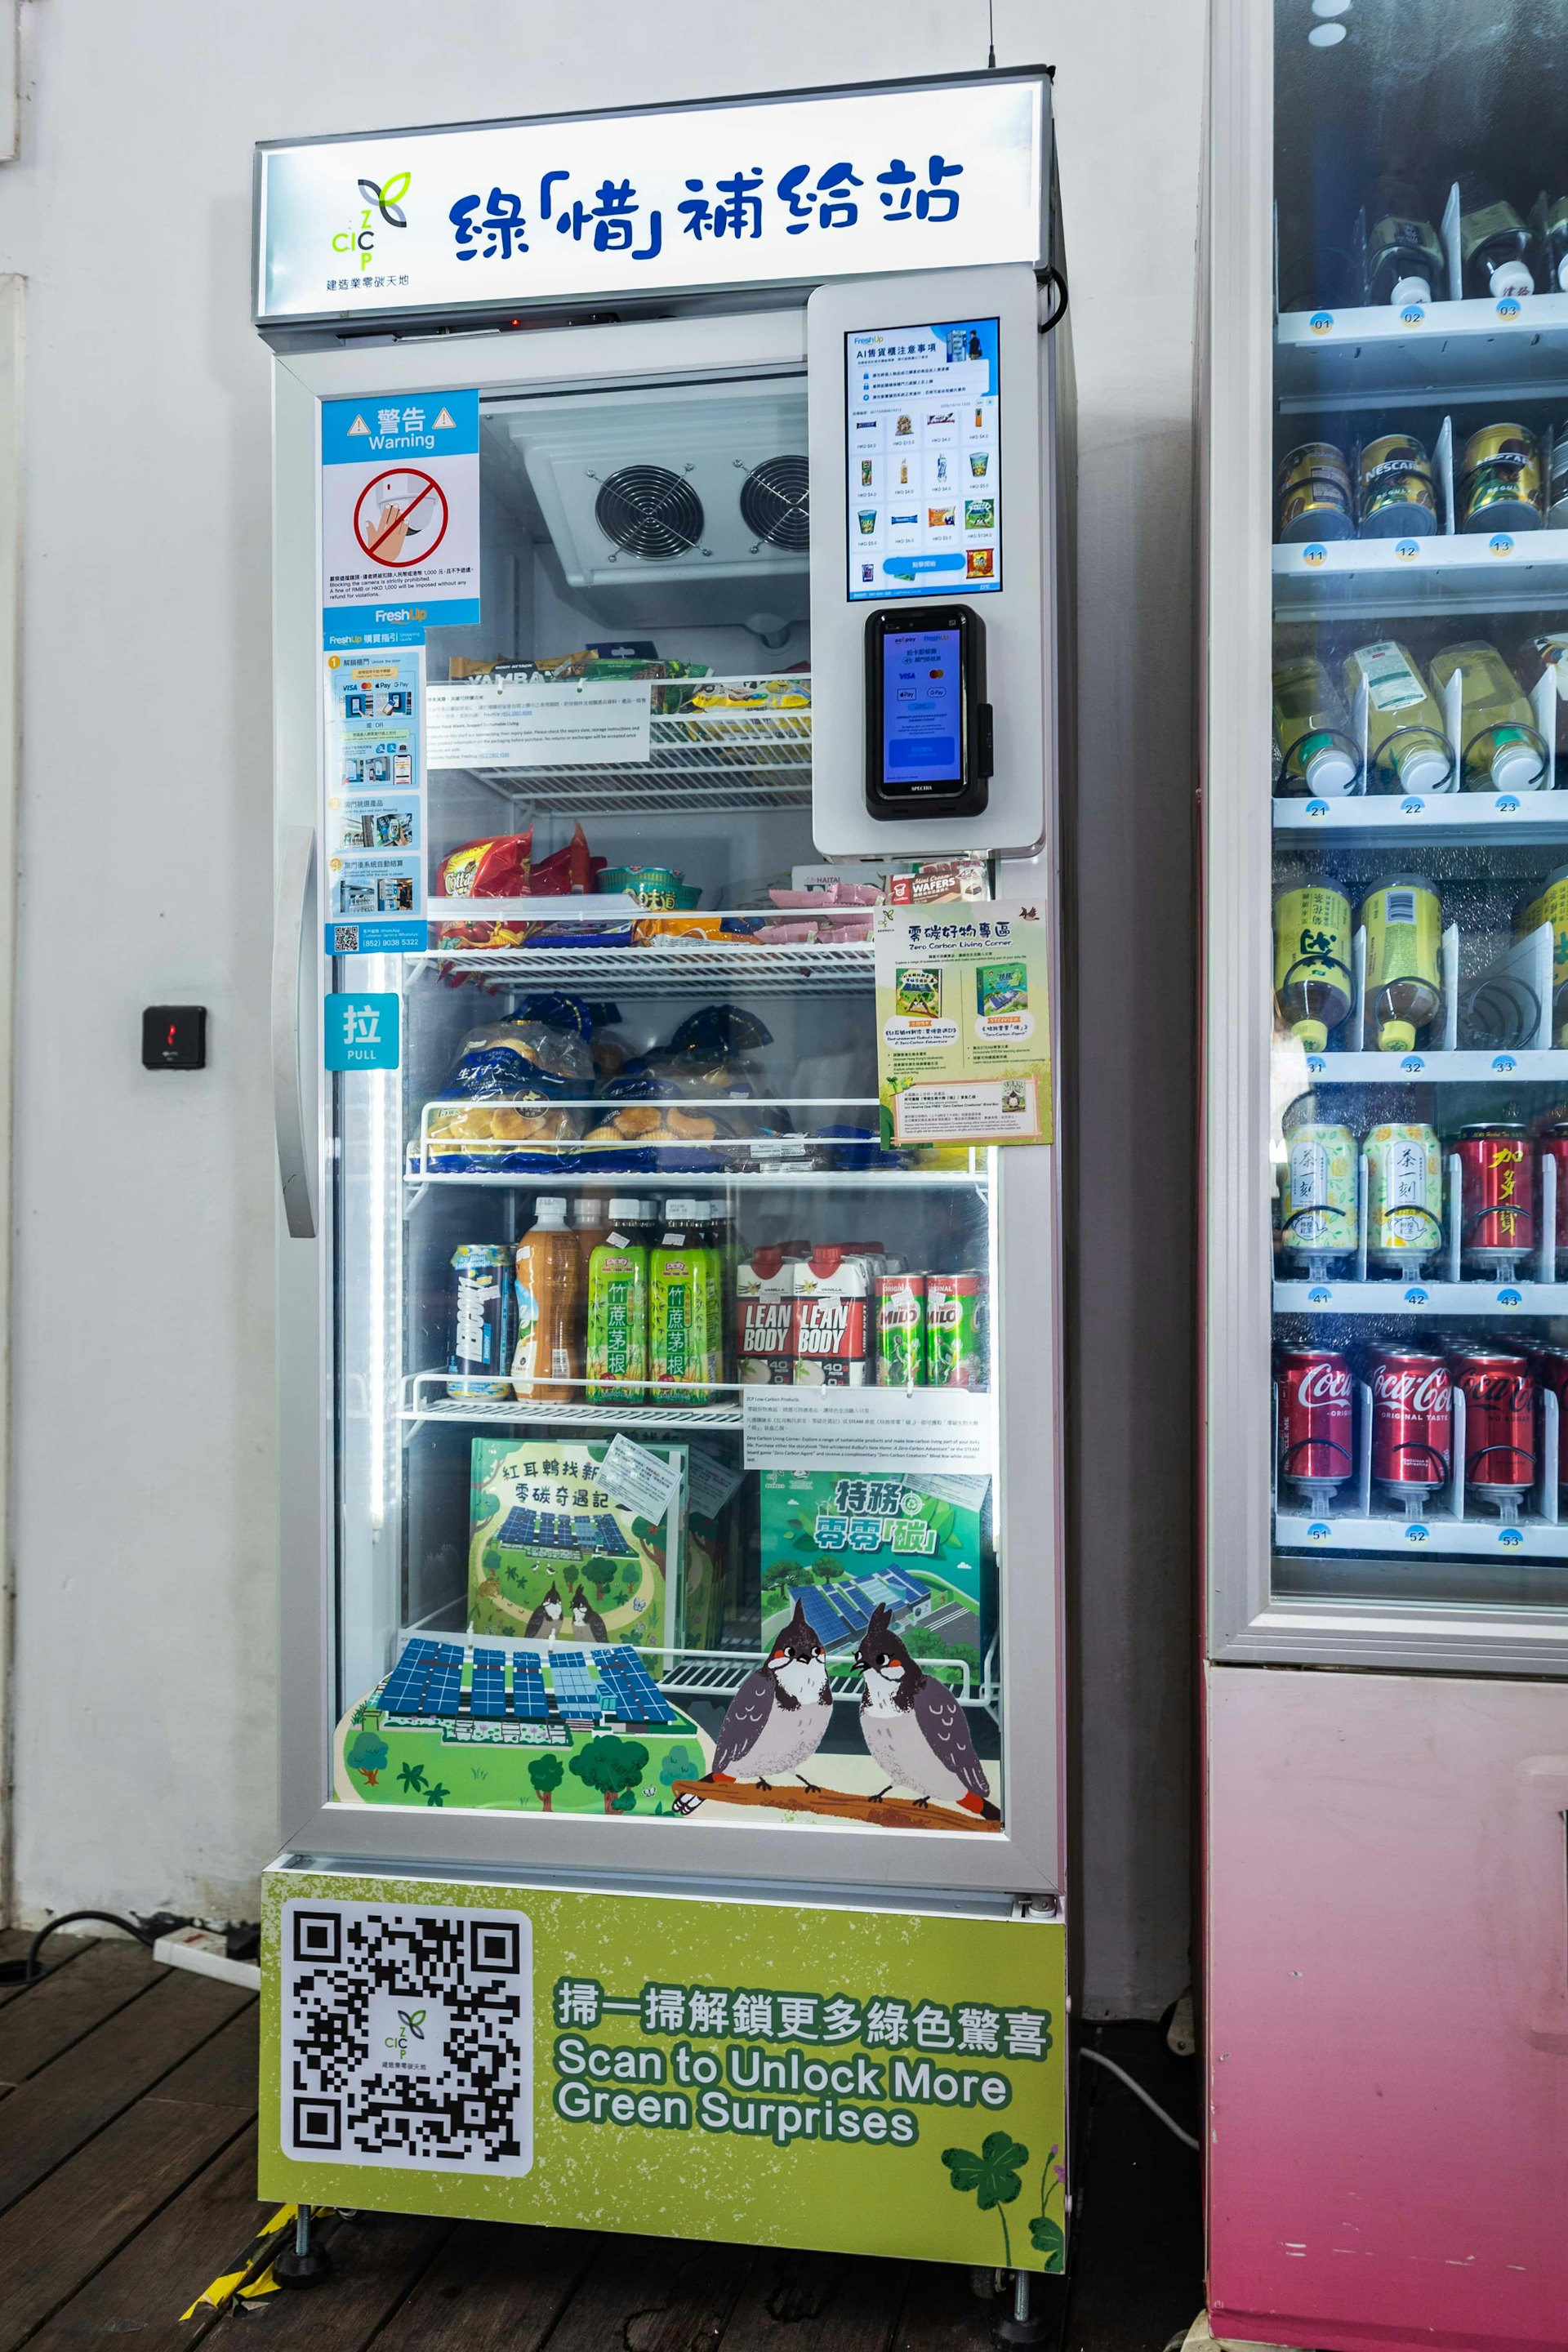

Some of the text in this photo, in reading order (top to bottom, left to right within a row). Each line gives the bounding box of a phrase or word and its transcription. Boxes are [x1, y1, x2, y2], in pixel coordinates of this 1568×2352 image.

[449, 156, 964, 261] 綠「惜」補給站
[327, 274, 409, 292] 建造業零碳天地
[1499, 305, 1517, 316] 03
[1314, 319, 1330, 329] 01
[1404, 313, 1421, 323] 02
[854, 336, 884, 344] FreshUp
[857, 343, 937, 359] AI售貨櫃注意事項
[377, 407, 425, 434] 警告
[369, 434, 434, 450] Warning
[1400, 546, 1415, 556] 12
[1494, 541, 1509, 551] 13
[1309, 550, 1324, 560] 11
[376, 608, 427, 621] FreshUp
[329, 632, 399, 645] FreshUp 購買指引
[1311, 807, 1325, 817] 21
[1405, 804, 1421, 813] 22
[1499, 802, 1516, 813] 23
[912, 877, 956, 893] WAFERS
[908, 921, 1011, 942] 零碳好物專區
[363, 939, 381, 947] (852)
[342, 1004, 382, 1045] 拉
[346, 1049, 376, 1061] PULL
[1405, 1062, 1422, 1072] 32
[1496, 1062, 1513, 1072] 33
[1397, 1148, 1416, 1200] 茶一刻
[1313, 1294, 1328, 1304] 41
[1408, 1295, 1425, 1305] 42
[1501, 1295, 1518, 1307] 43
[746, 1305, 792, 1329] LEAN
[800, 1305, 849, 1329] LEAN
[880, 1310, 917, 1325] MILO
[608, 1283, 626, 1374] 竹蔗茅根
[668, 1287, 684, 1374] 竹蔗茅根
[743, 1328, 788, 1352] BODY
[798, 1330, 844, 1353] BODY
[823, 1363, 849, 1372] 40g
[1382, 1412, 1423, 1420] ORIGINAL
[515, 1483, 609, 1509] 零碳奇遇記
[835, 1479, 902, 1515] 特務
[814, 1515, 939, 1555] 零零「碳」
[1312, 1530, 1328, 1540] 51
[1410, 1532, 1426, 1542] 52
[1503, 1535, 1520, 1546] 53
[559, 1982, 1047, 2056] 掃一掃解鎖更多綠色驚喜
[559, 2040, 1007, 2105] Scan to Unlock More
[559, 2082, 914, 2141] Green Surprises
